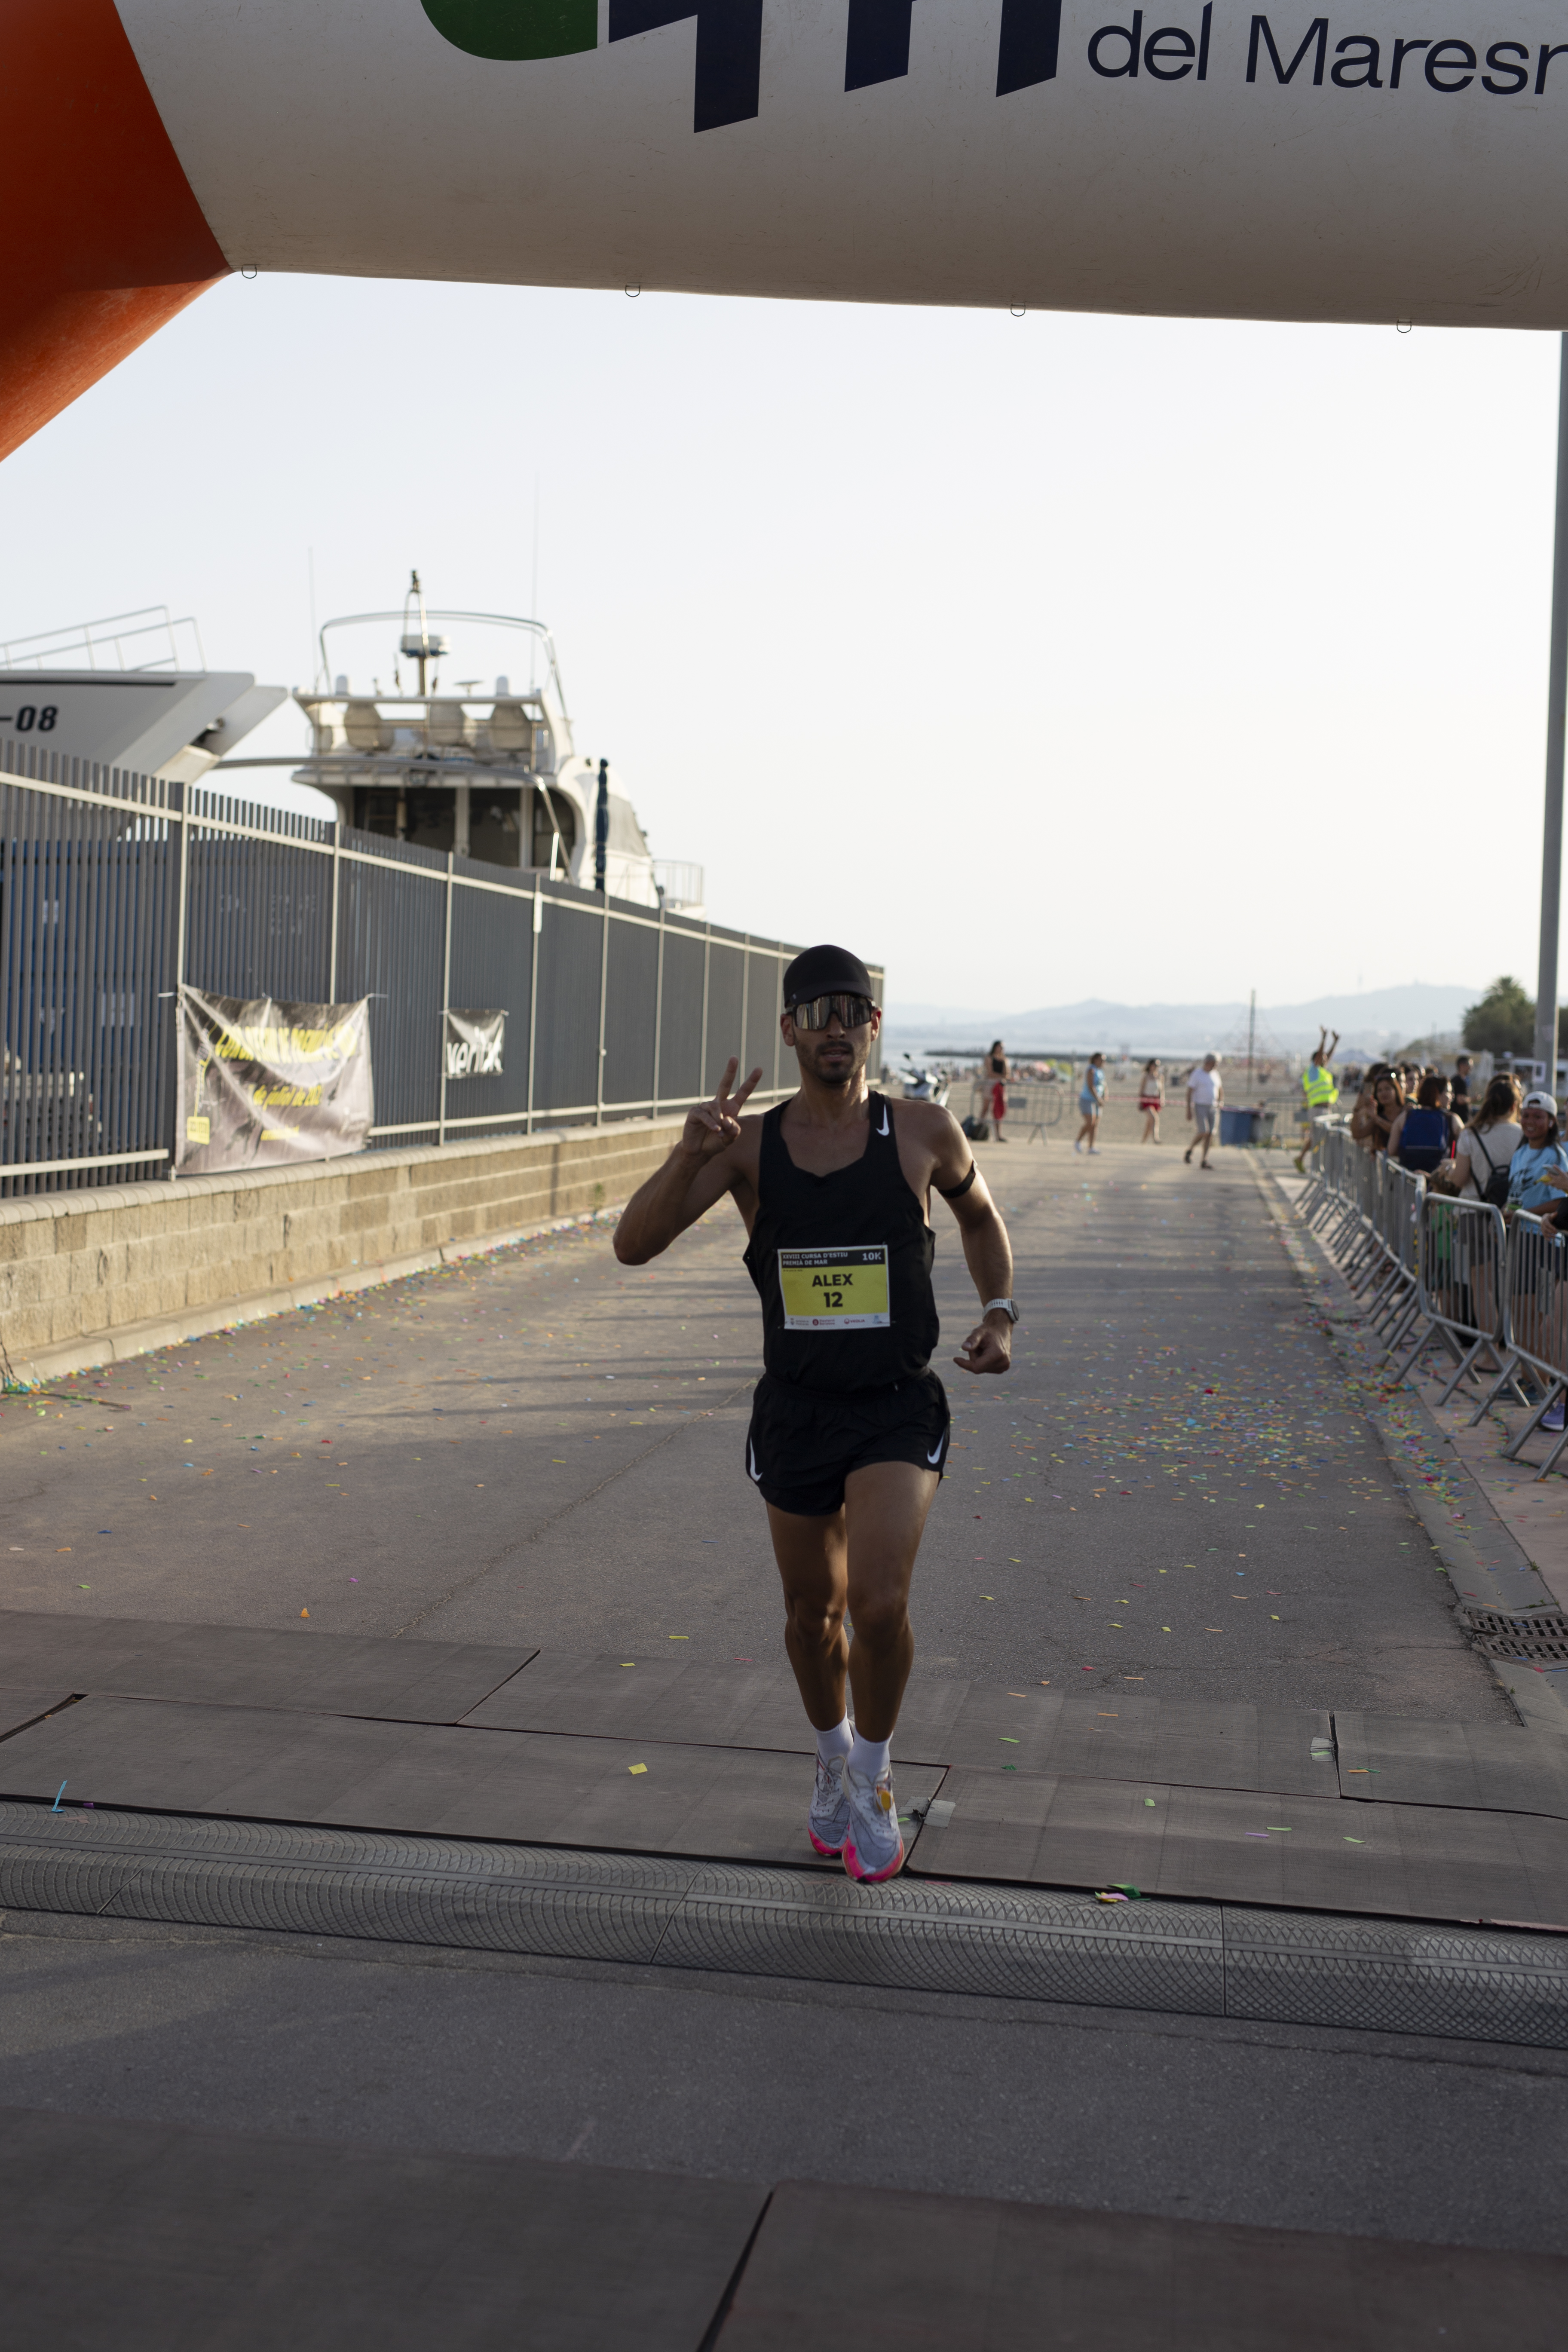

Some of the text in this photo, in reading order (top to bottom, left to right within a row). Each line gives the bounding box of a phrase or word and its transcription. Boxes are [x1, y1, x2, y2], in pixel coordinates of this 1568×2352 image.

[1087, 0, 1213, 81] del
[862, 1252, 882, 1261] 10K
[812, 1274, 854, 1287] ALEX
[824, 1292, 843, 1308] 12
